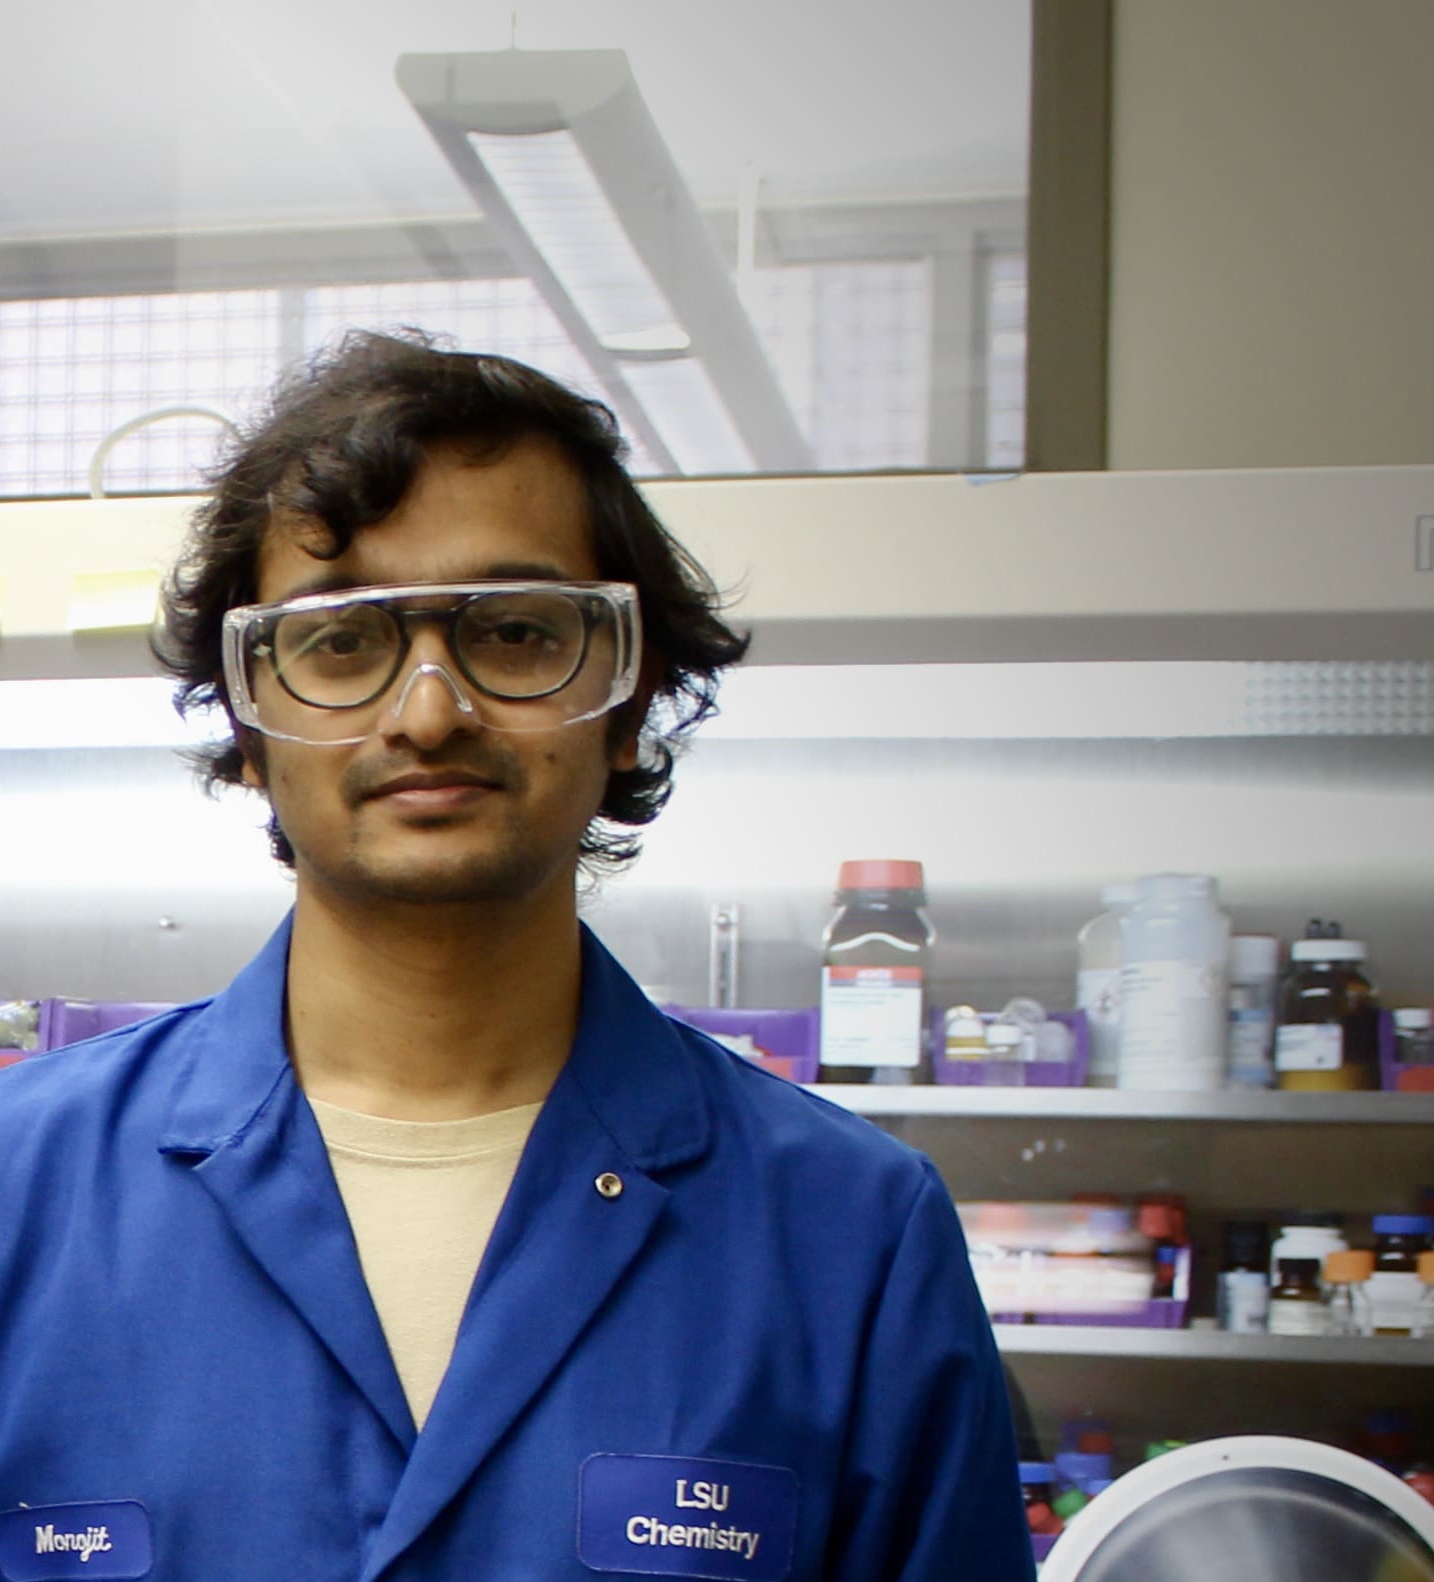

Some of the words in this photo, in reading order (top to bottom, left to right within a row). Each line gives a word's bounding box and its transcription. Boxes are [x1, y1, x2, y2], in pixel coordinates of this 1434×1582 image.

[674, 1478, 730, 1512] LSU
[34, 1524, 113, 1563] Monojit
[625, 1515, 760, 1561] Chemistry
